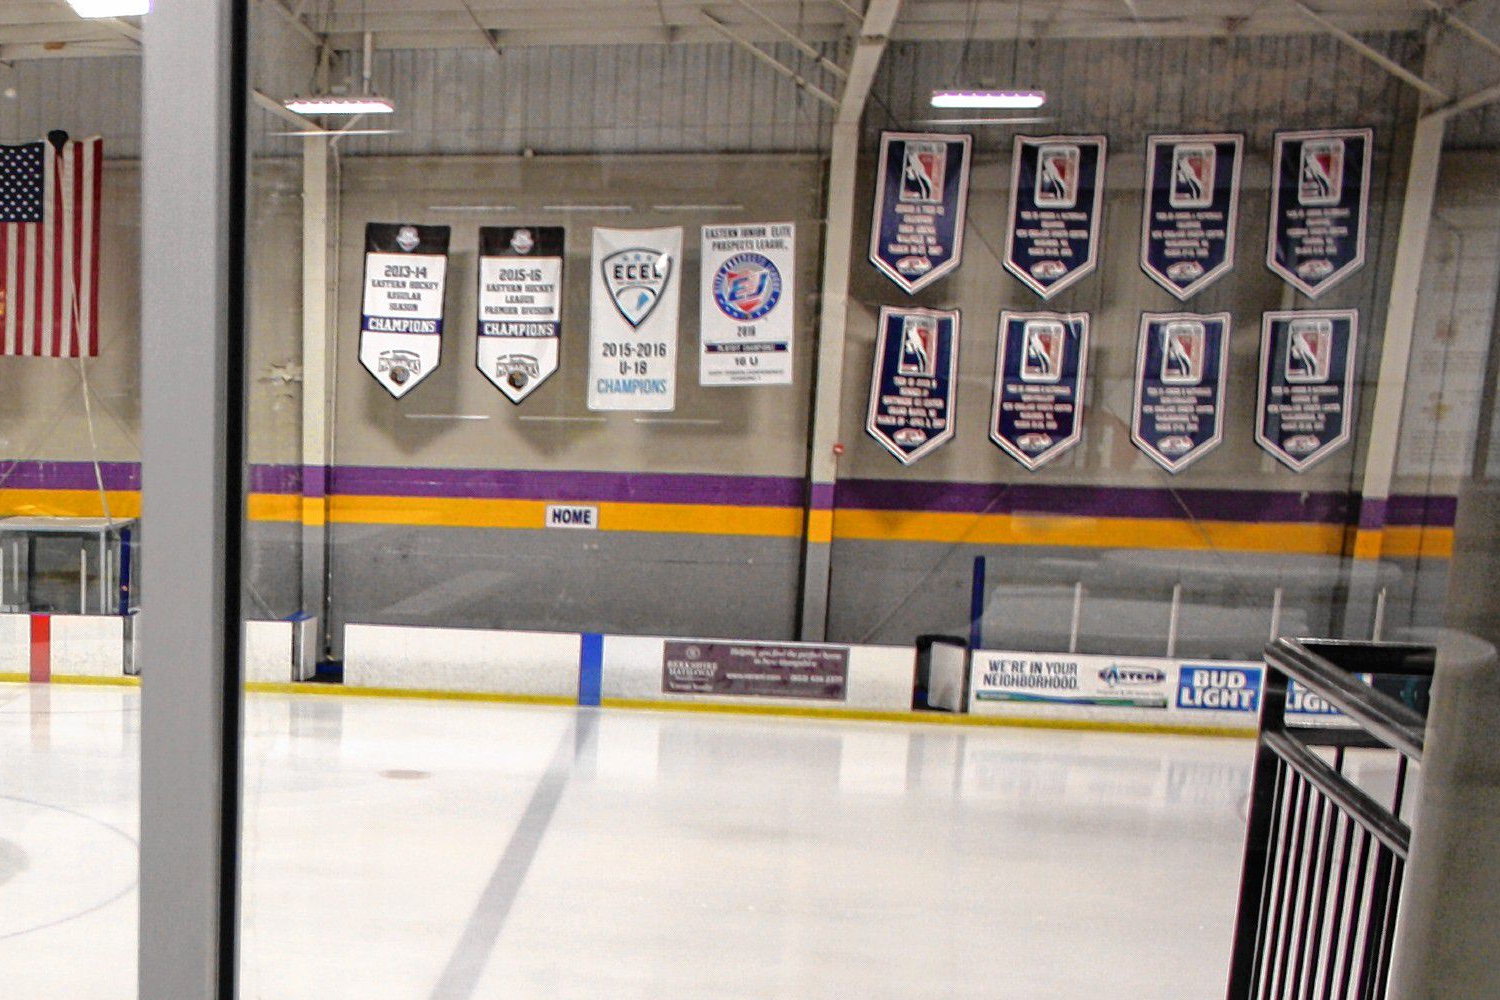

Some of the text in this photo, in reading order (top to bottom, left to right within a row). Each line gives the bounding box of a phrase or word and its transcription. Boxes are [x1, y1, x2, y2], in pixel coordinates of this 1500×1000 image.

[613, 263, 663, 280] ECEL
[369, 317, 437, 333] CHAMPIONS
[484, 322, 554, 337] CHAMPIONS
[602, 342, 667, 358] 2015-2016
[619, 361, 648, 375] U-18
[597, 378, 667, 394] CHAMPIONS
[552, 508, 592, 525] HOME
[1029, 660, 1043, 674] IN
[1046, 661, 1078, 676] YOUR
[1193, 669, 1247, 689] BUD
[1181, 686, 1254, 707] LIGHT
